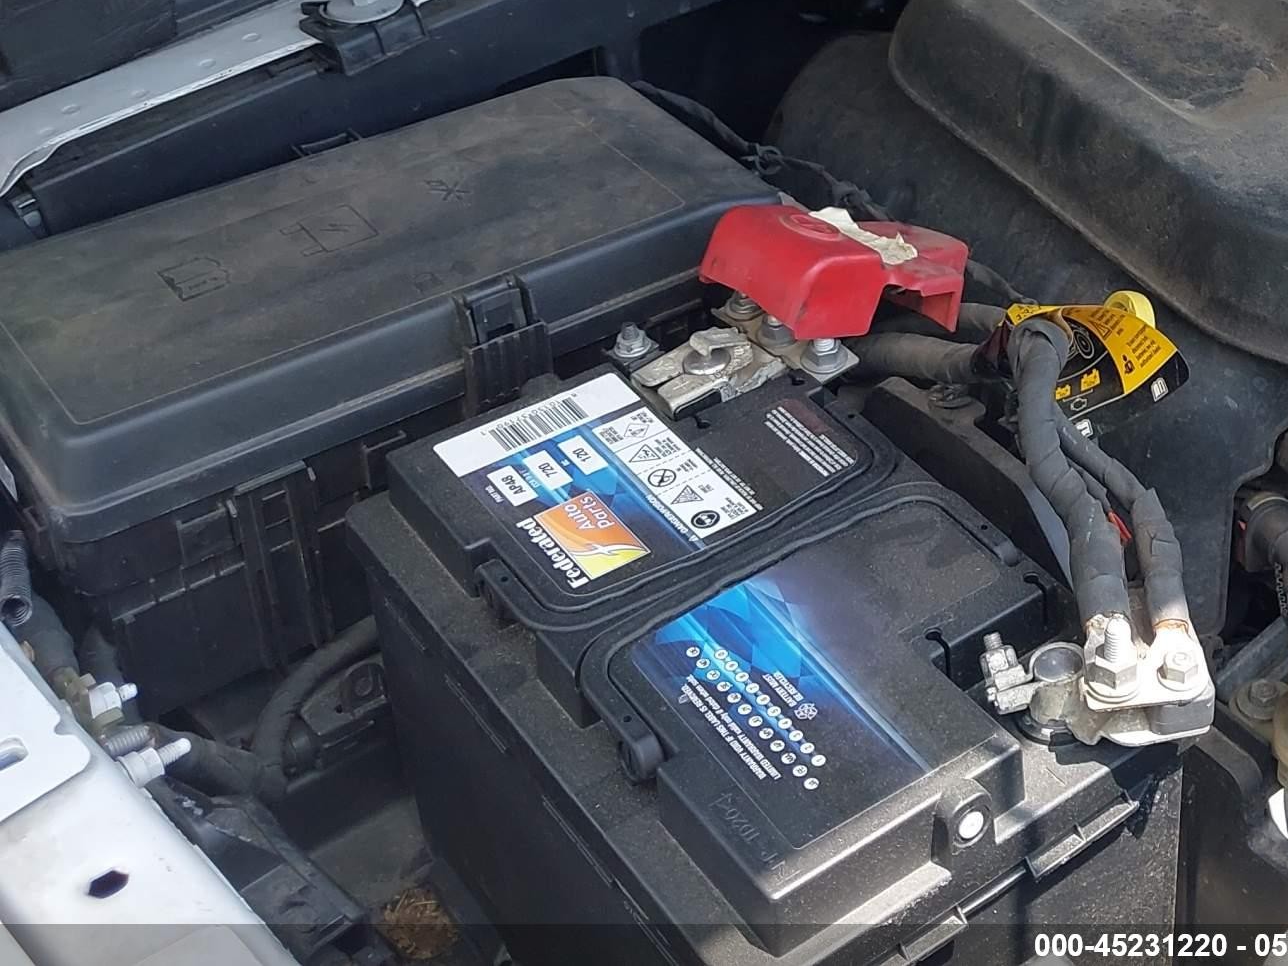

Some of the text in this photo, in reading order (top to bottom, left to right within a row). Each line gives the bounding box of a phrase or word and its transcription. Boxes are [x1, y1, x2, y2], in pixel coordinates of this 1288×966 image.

[572, 447, 593, 462] 120
[536, 461, 558, 477] 720
[500, 474, 526, 495] AP48
[560, 502, 596, 531] Auto
[577, 495, 616, 528] Parts
[515, 517, 589, 587] Federated
[761, 673, 797, 707] BATTERY MUST
[702, 710, 721, 726] LABEL
[714, 724, 730, 736] THIS
[728, 740, 745, 753] VOID
[737, 733, 765, 760] WARRANTY
[738, 751, 767, 779] WARRANTY
[759, 758, 782, 779] LIMITED
